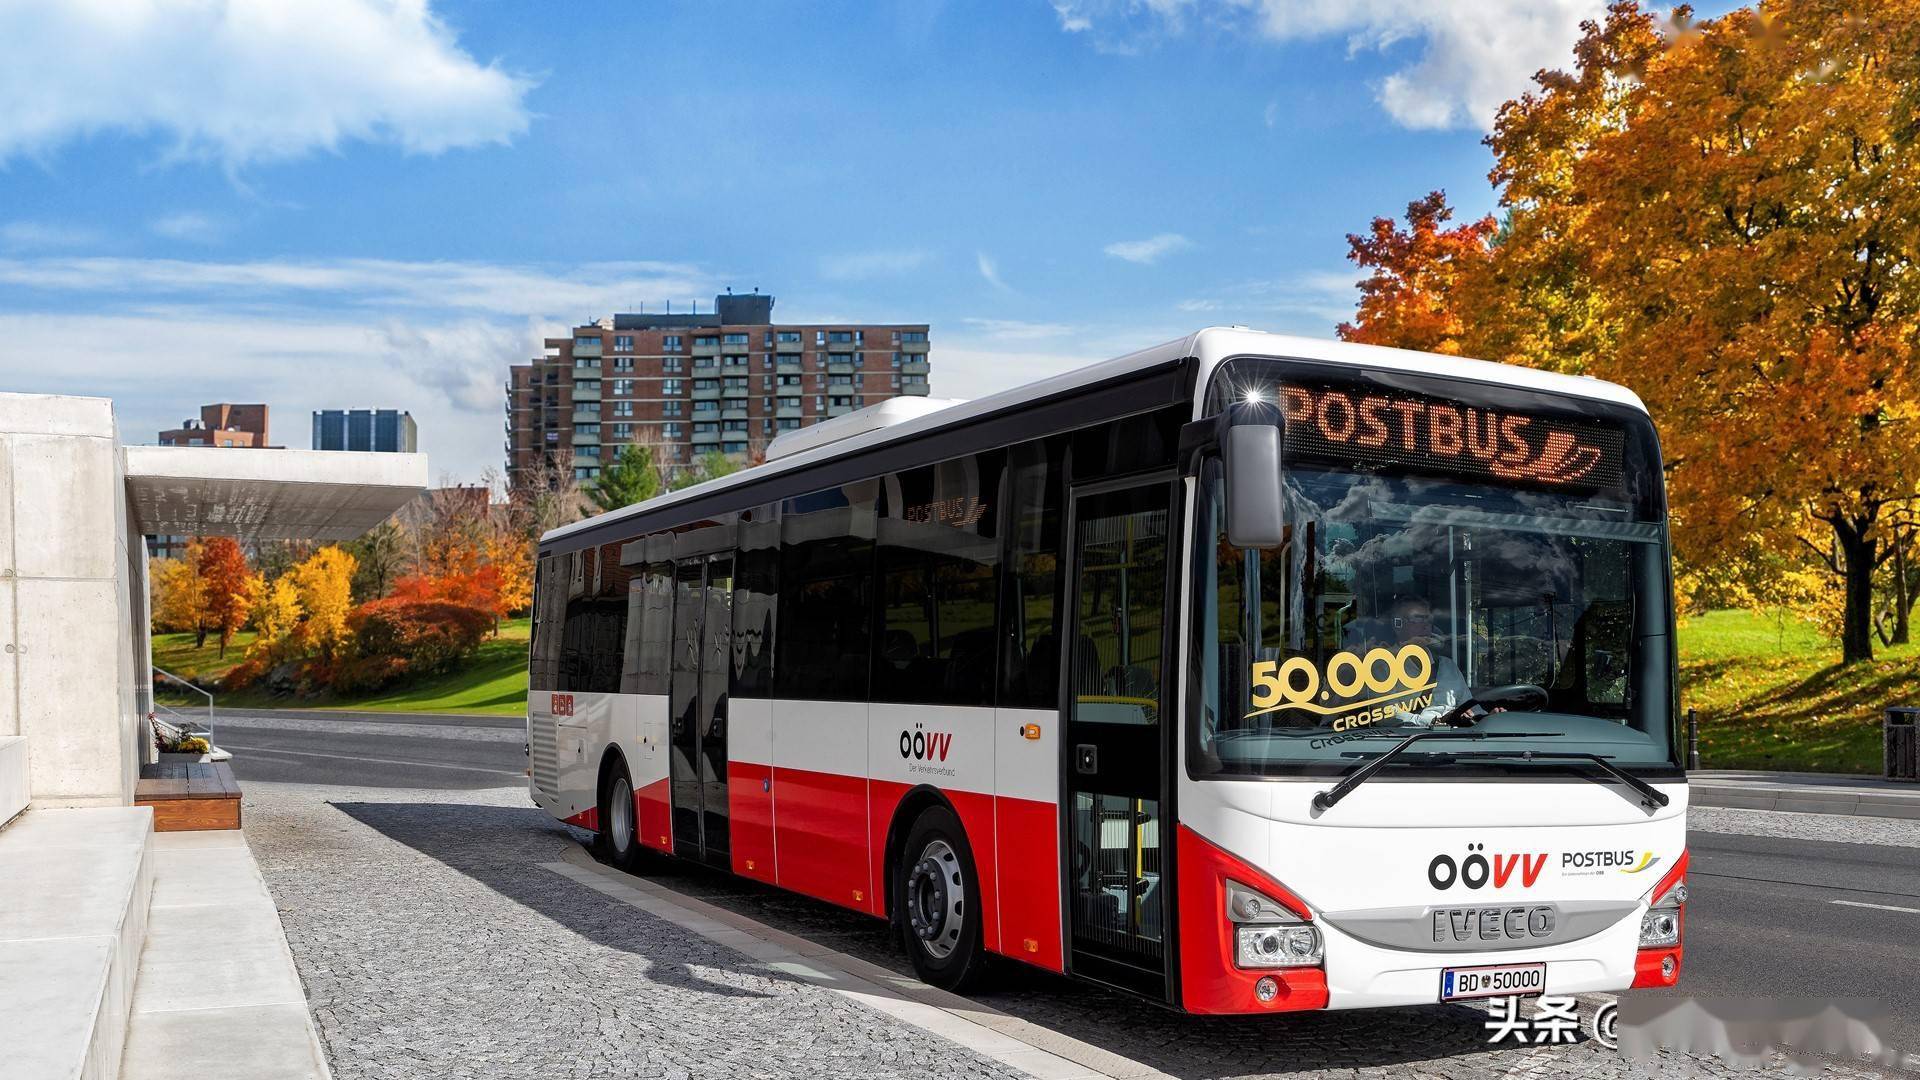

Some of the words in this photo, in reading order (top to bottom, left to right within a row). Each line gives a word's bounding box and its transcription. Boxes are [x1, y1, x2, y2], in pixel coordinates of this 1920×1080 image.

[1279, 383, 1531, 463] POSTBUS
[1252, 644, 1432, 708] 50.000
[1333, 693, 1433, 732] CROSSWAY
[900, 722, 952, 762] OÖVV
[1428, 843, 1549, 890] OÖVV
[1562, 850, 1634, 868] POSTBUS
[1433, 906, 1556, 943] IVECO
[1459, 974, 1479, 992] BD
[1493, 970, 1540, 989] 50000
